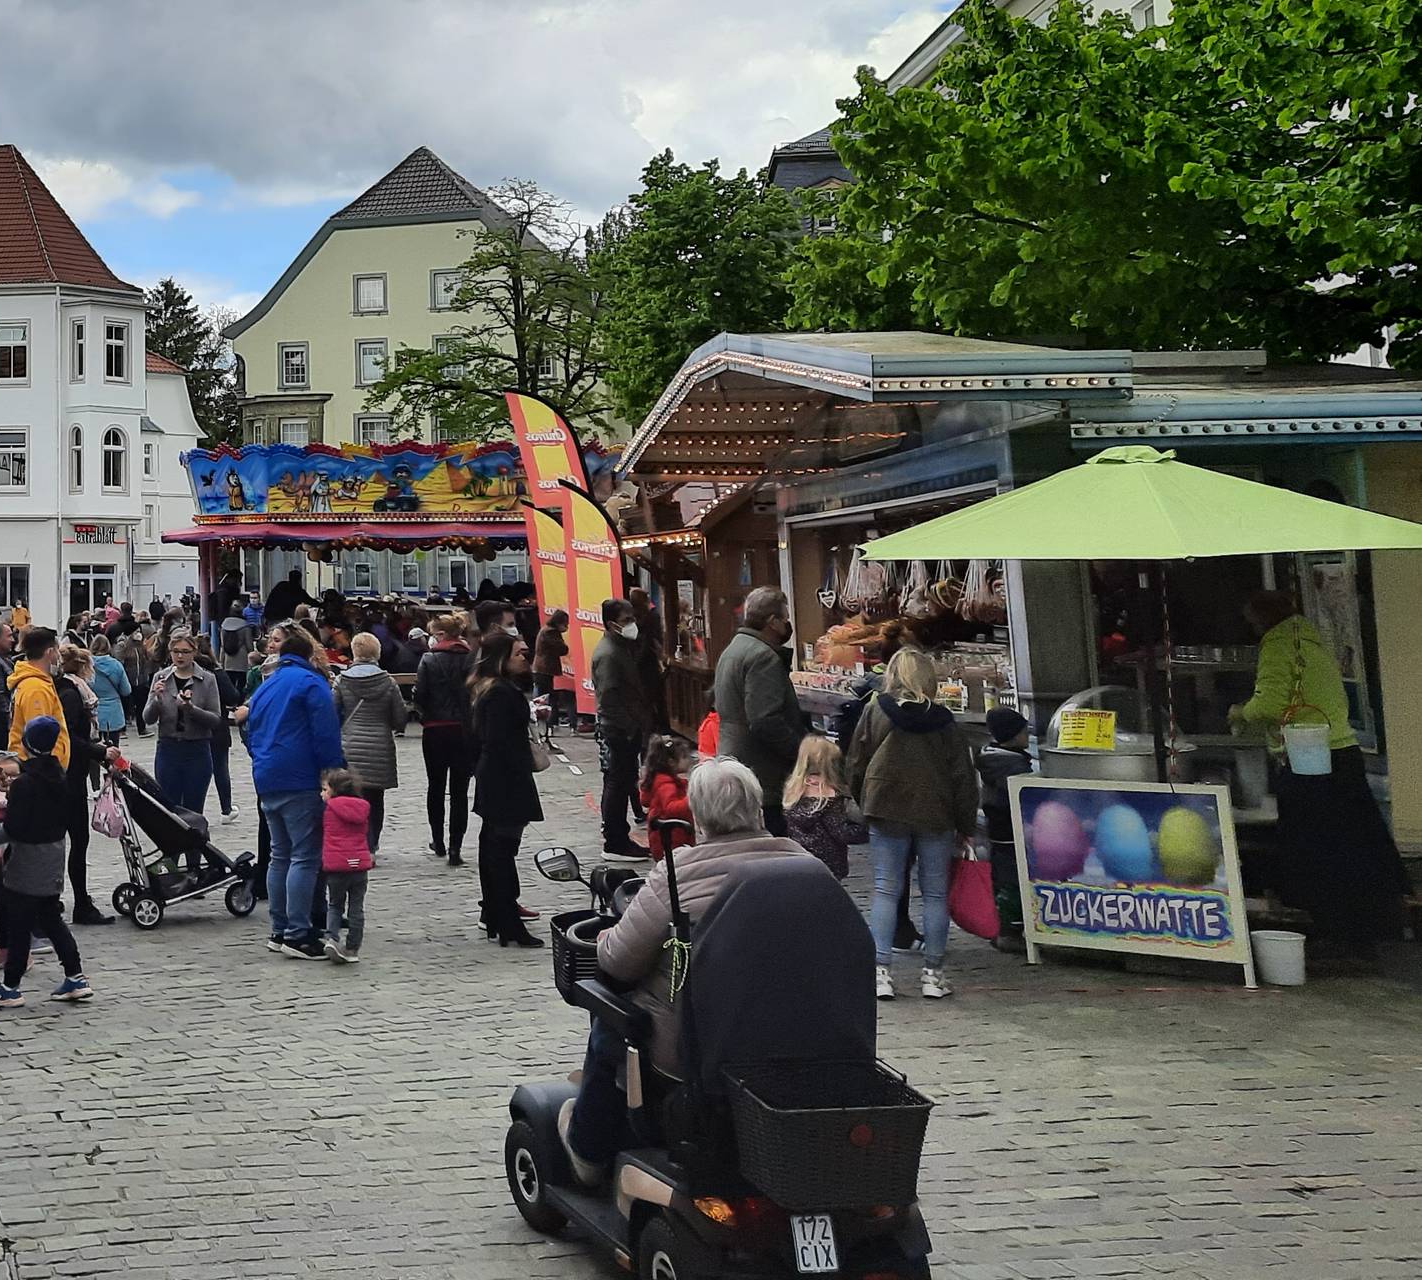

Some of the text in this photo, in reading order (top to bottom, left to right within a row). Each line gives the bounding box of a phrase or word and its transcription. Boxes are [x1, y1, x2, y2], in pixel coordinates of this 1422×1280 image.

[76, 526, 117, 544] extrablatt
[1041, 890, 1220, 937] ZUCKERWATTE
[798, 1217, 831, 1240] 172
[801, 1245, 834, 1267] CIX
